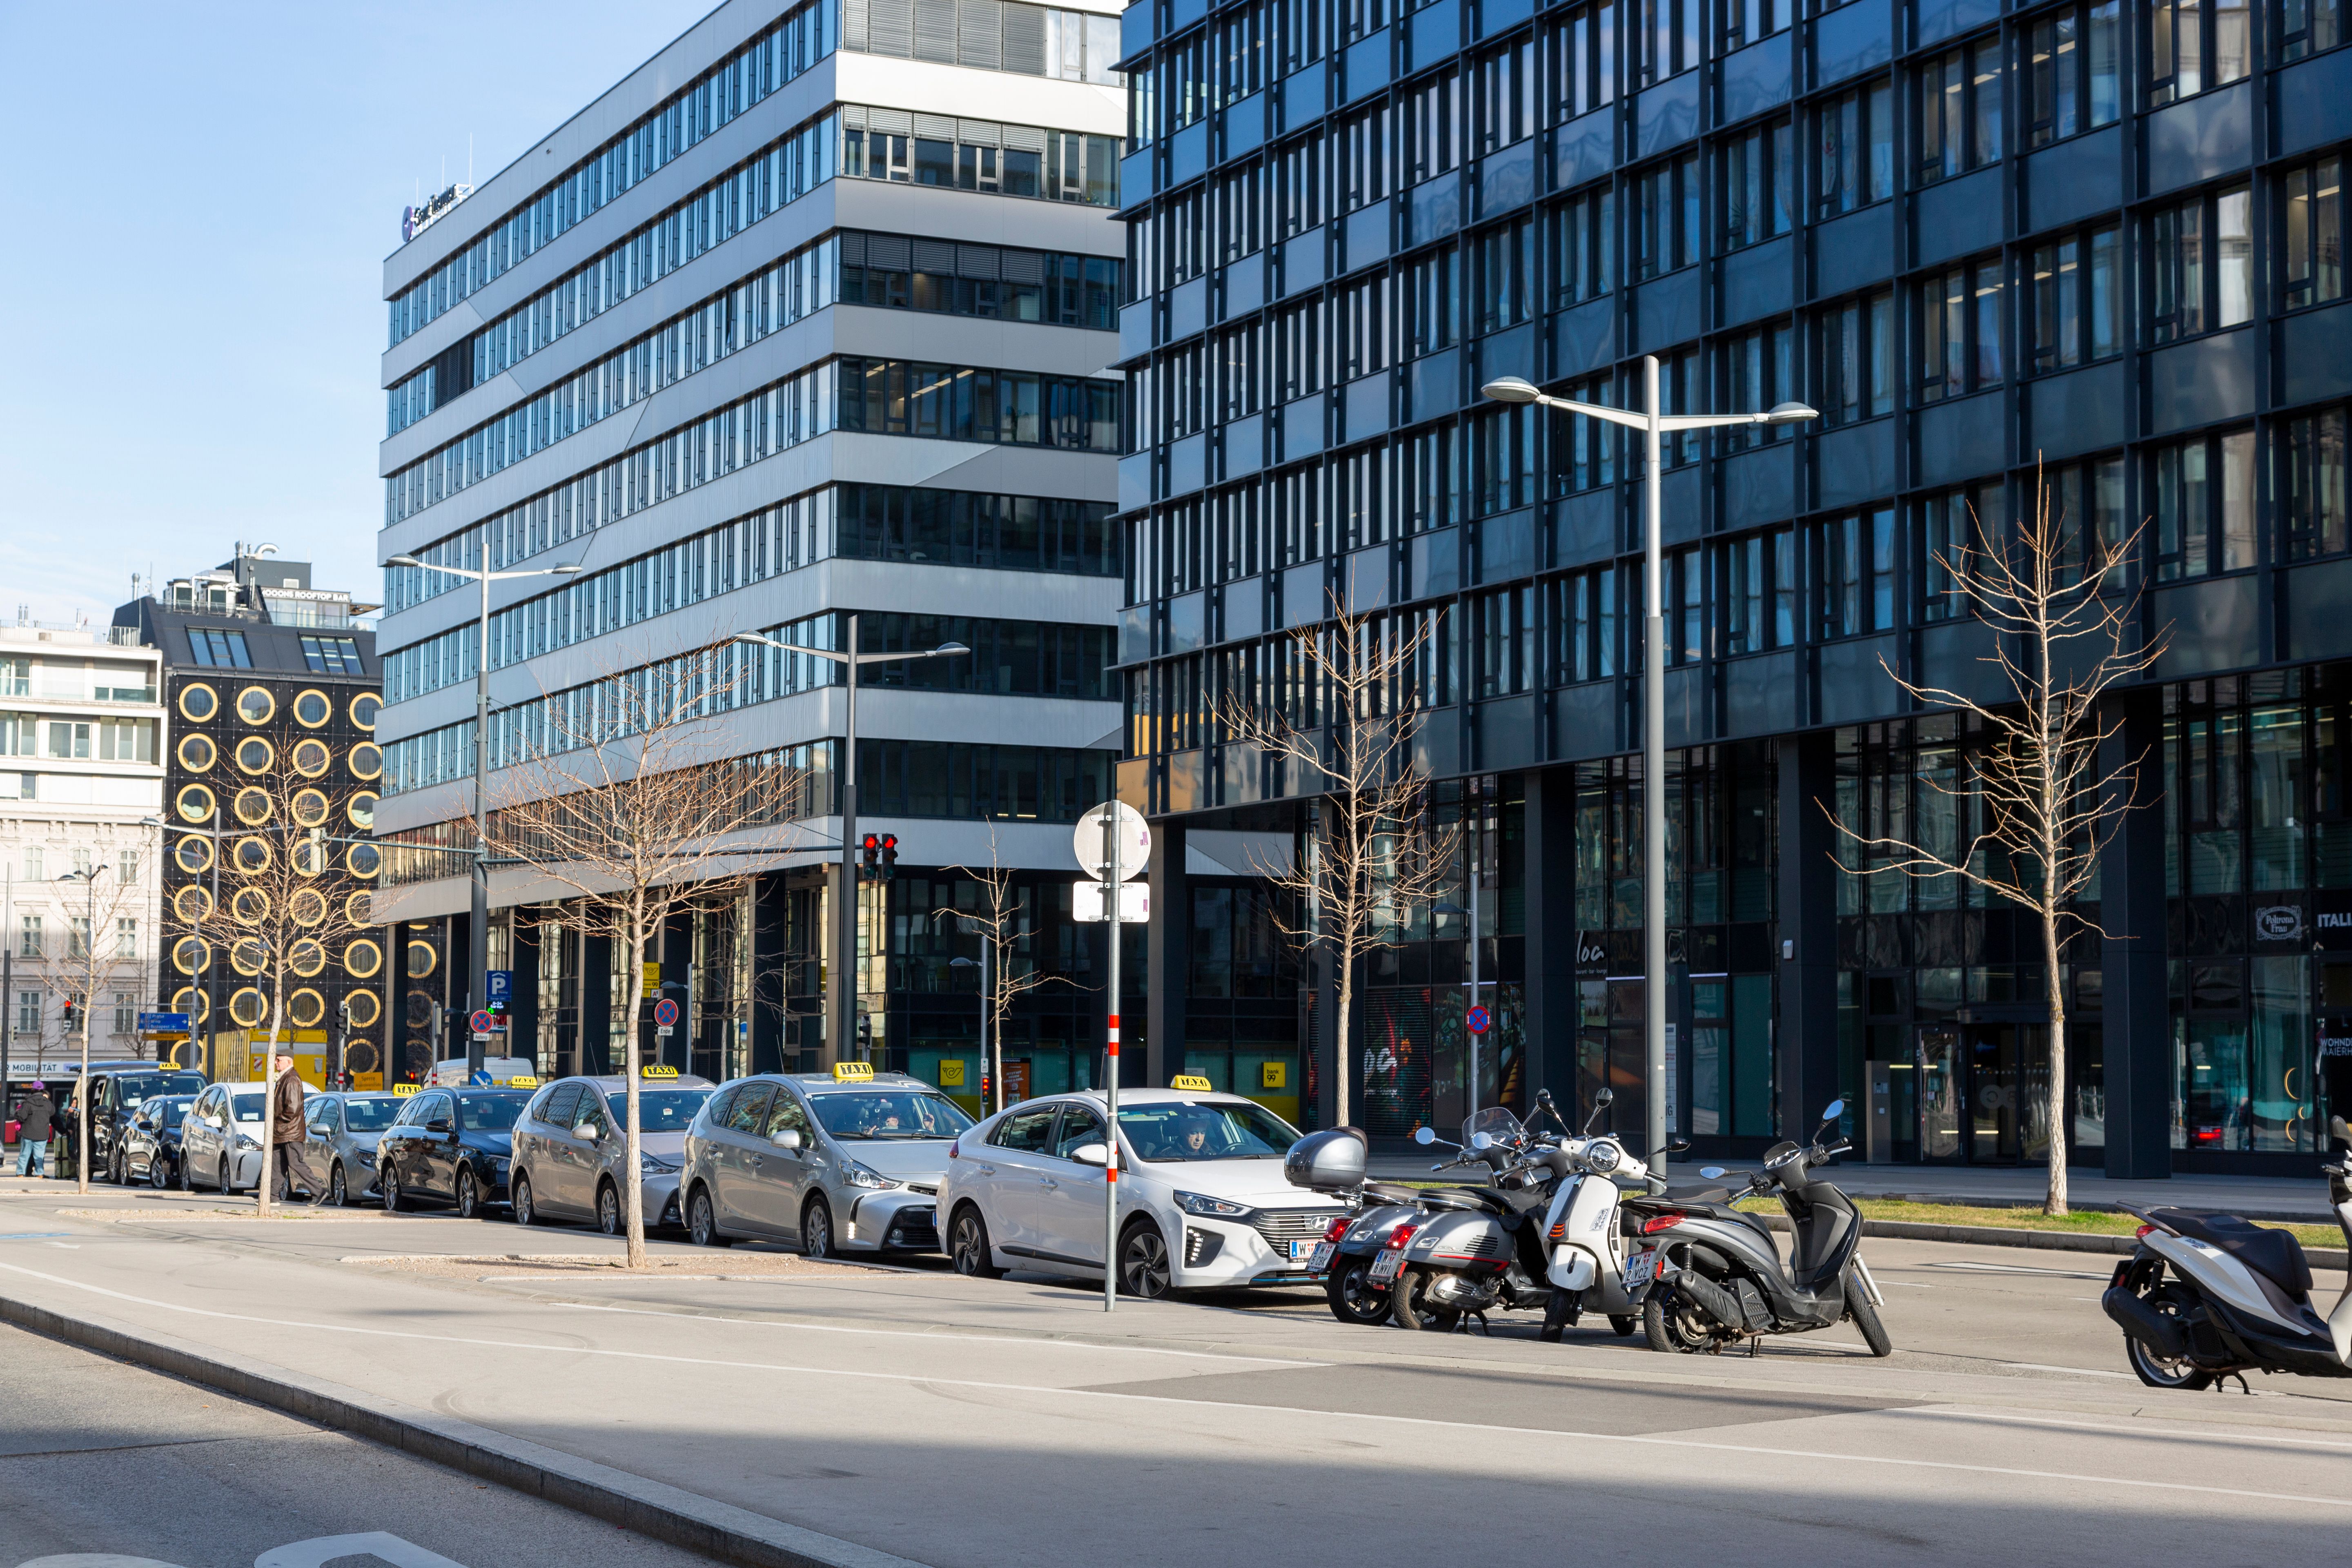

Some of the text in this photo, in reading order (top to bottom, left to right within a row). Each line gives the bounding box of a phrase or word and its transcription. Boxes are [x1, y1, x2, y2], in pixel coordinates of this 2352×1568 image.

[295, 591, 332, 600] ROOFTOP
[2266, 915, 2294, 924] Poltrona
[2271, 924, 2287, 933] Frau
[492, 978, 506, 995] P
[2320, 1038, 2352, 1047] WOHND
[842, 1065, 870, 1074] TAXI
[1181, 1078, 1207, 1086] TAXI
[398, 1086, 421, 1094] TAXI
[1299, 1243, 1306, 1255] W
[1320, 1245, 1326, 1254] W
[1311, 1256, 1316, 1265] 5
[1316, 1256, 1327, 1266] CBK
[1383, 1252, 1390, 1262] W
[1635, 1256, 1643, 1267] W
[1374, 1263, 1380, 1273] 6
[1627, 1267, 1648, 1281] 2 VCZ
